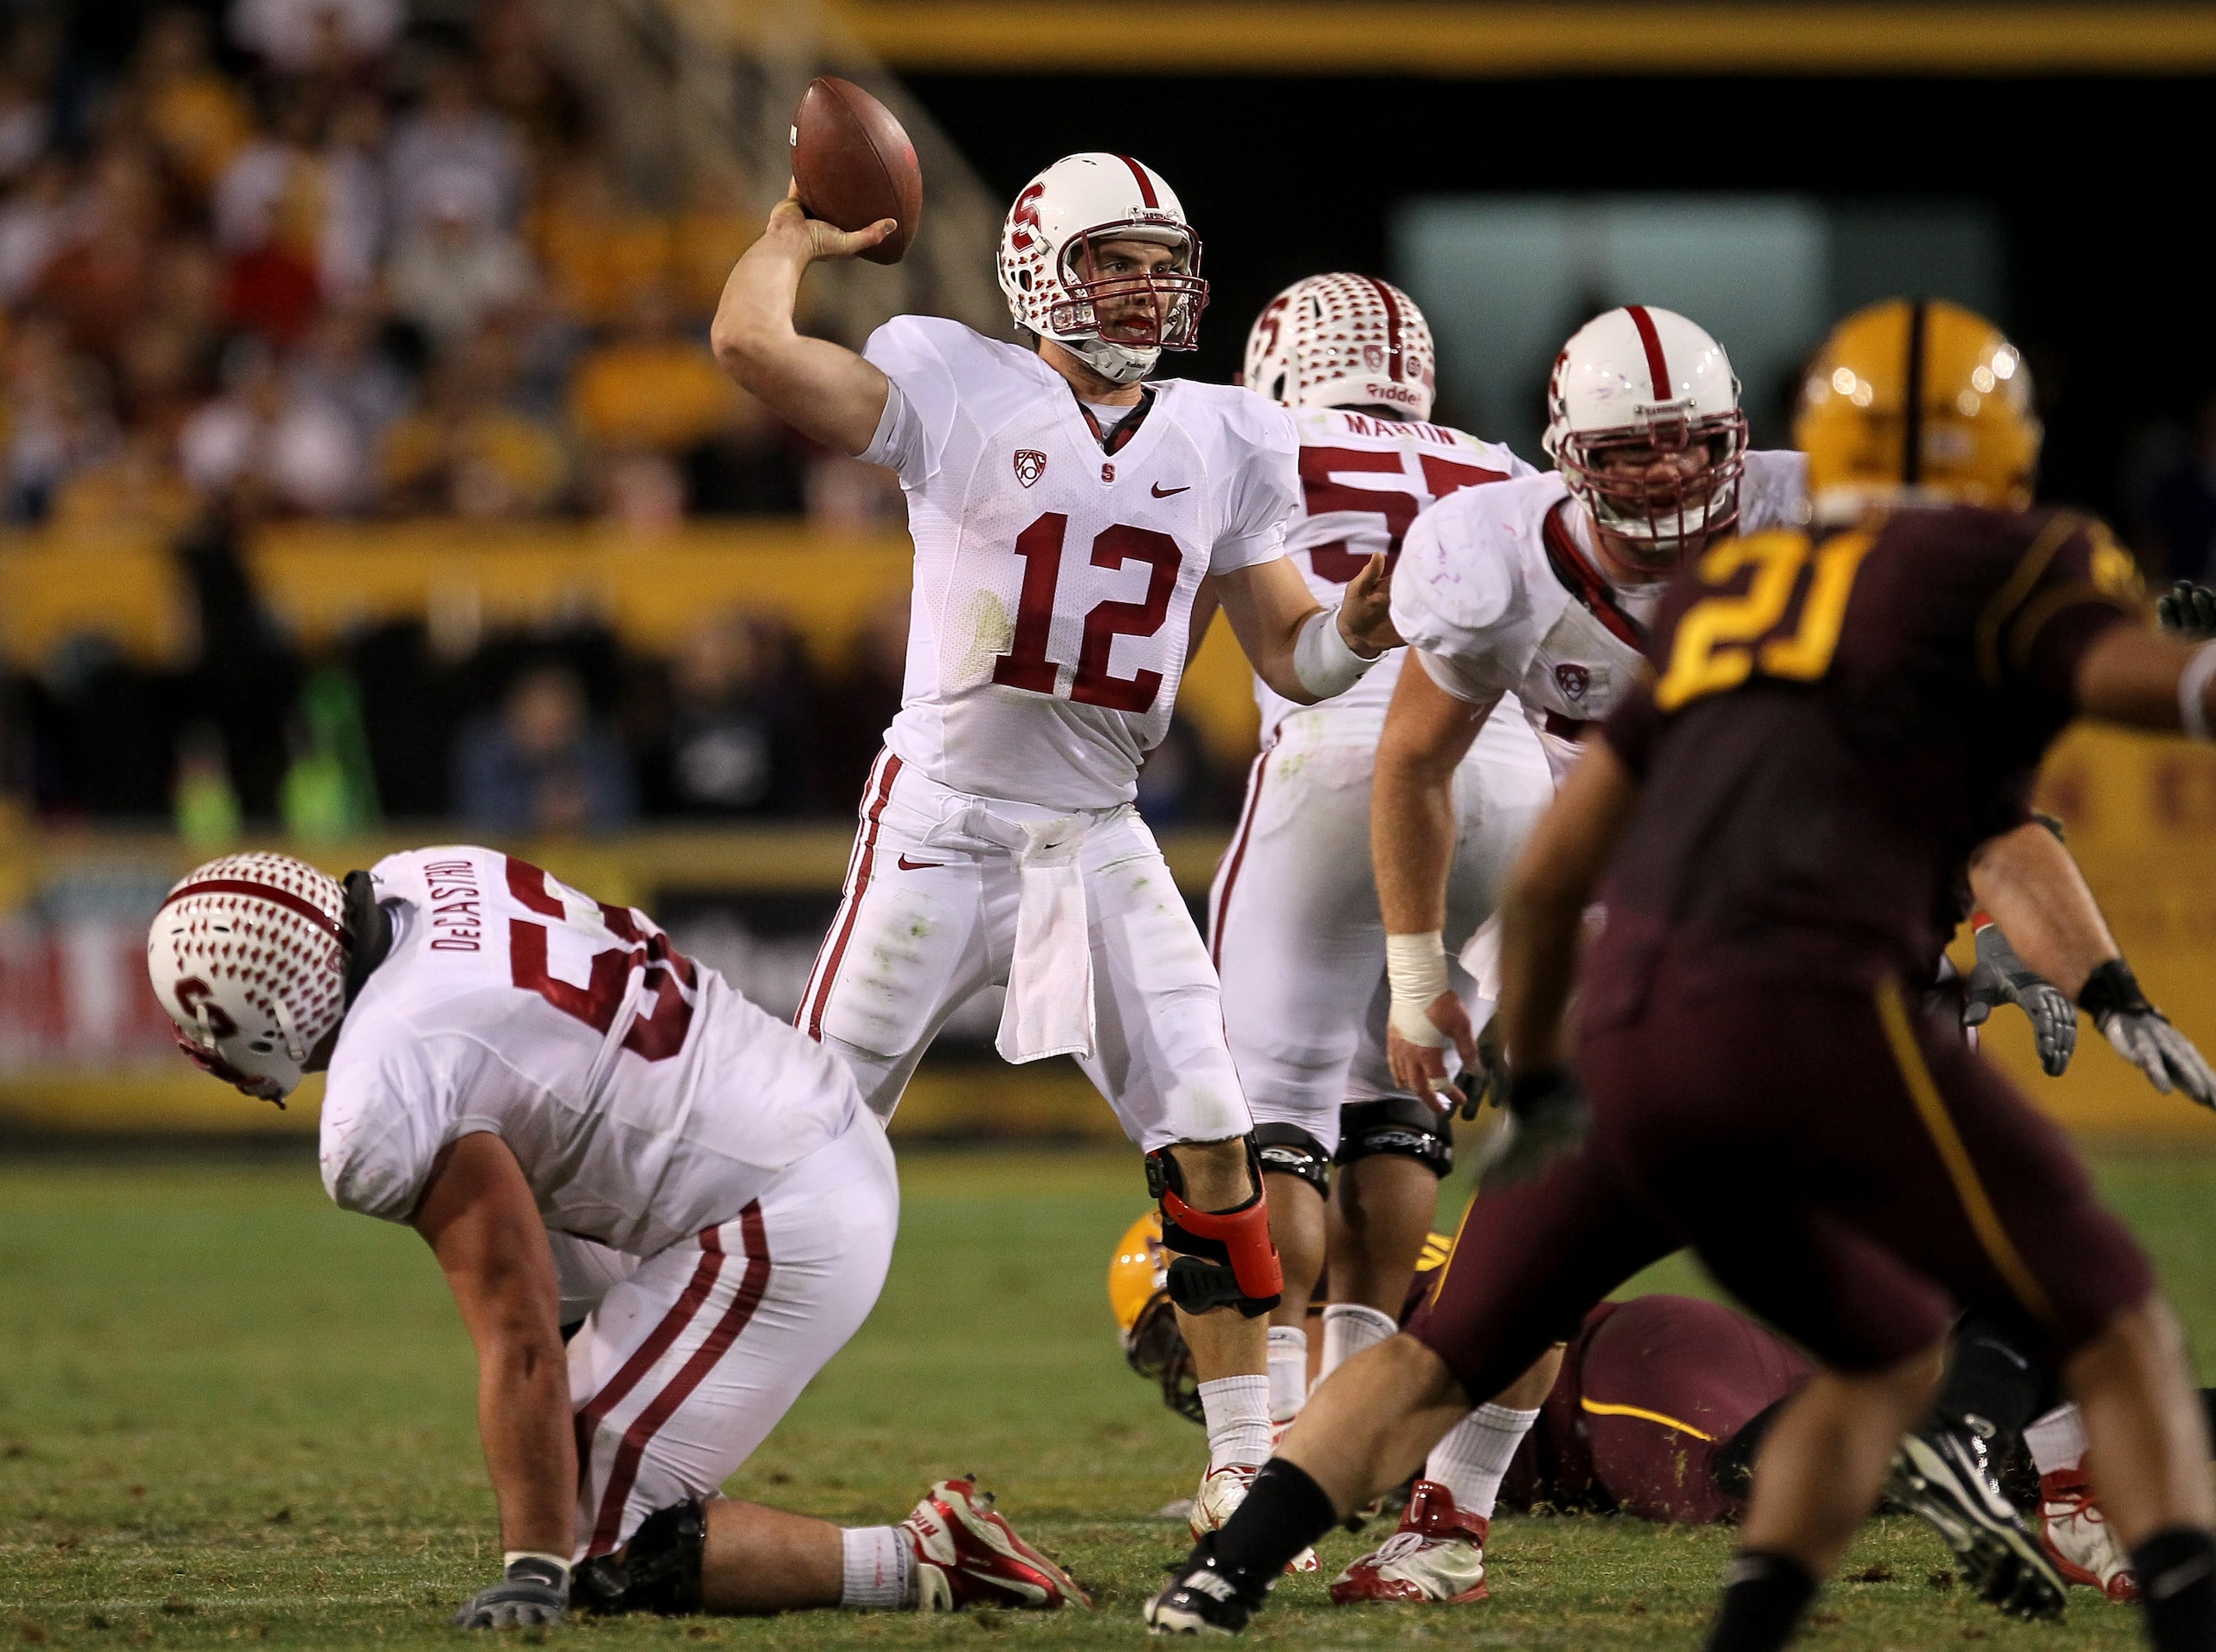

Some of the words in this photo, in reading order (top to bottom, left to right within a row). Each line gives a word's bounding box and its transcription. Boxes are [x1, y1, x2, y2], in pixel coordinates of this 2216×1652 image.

[1011, 180, 1046, 253] S
[1343, 414, 1457, 446] MARTIN
[991, 511, 1183, 715] 12
[1653, 524, 1880, 712] 21
